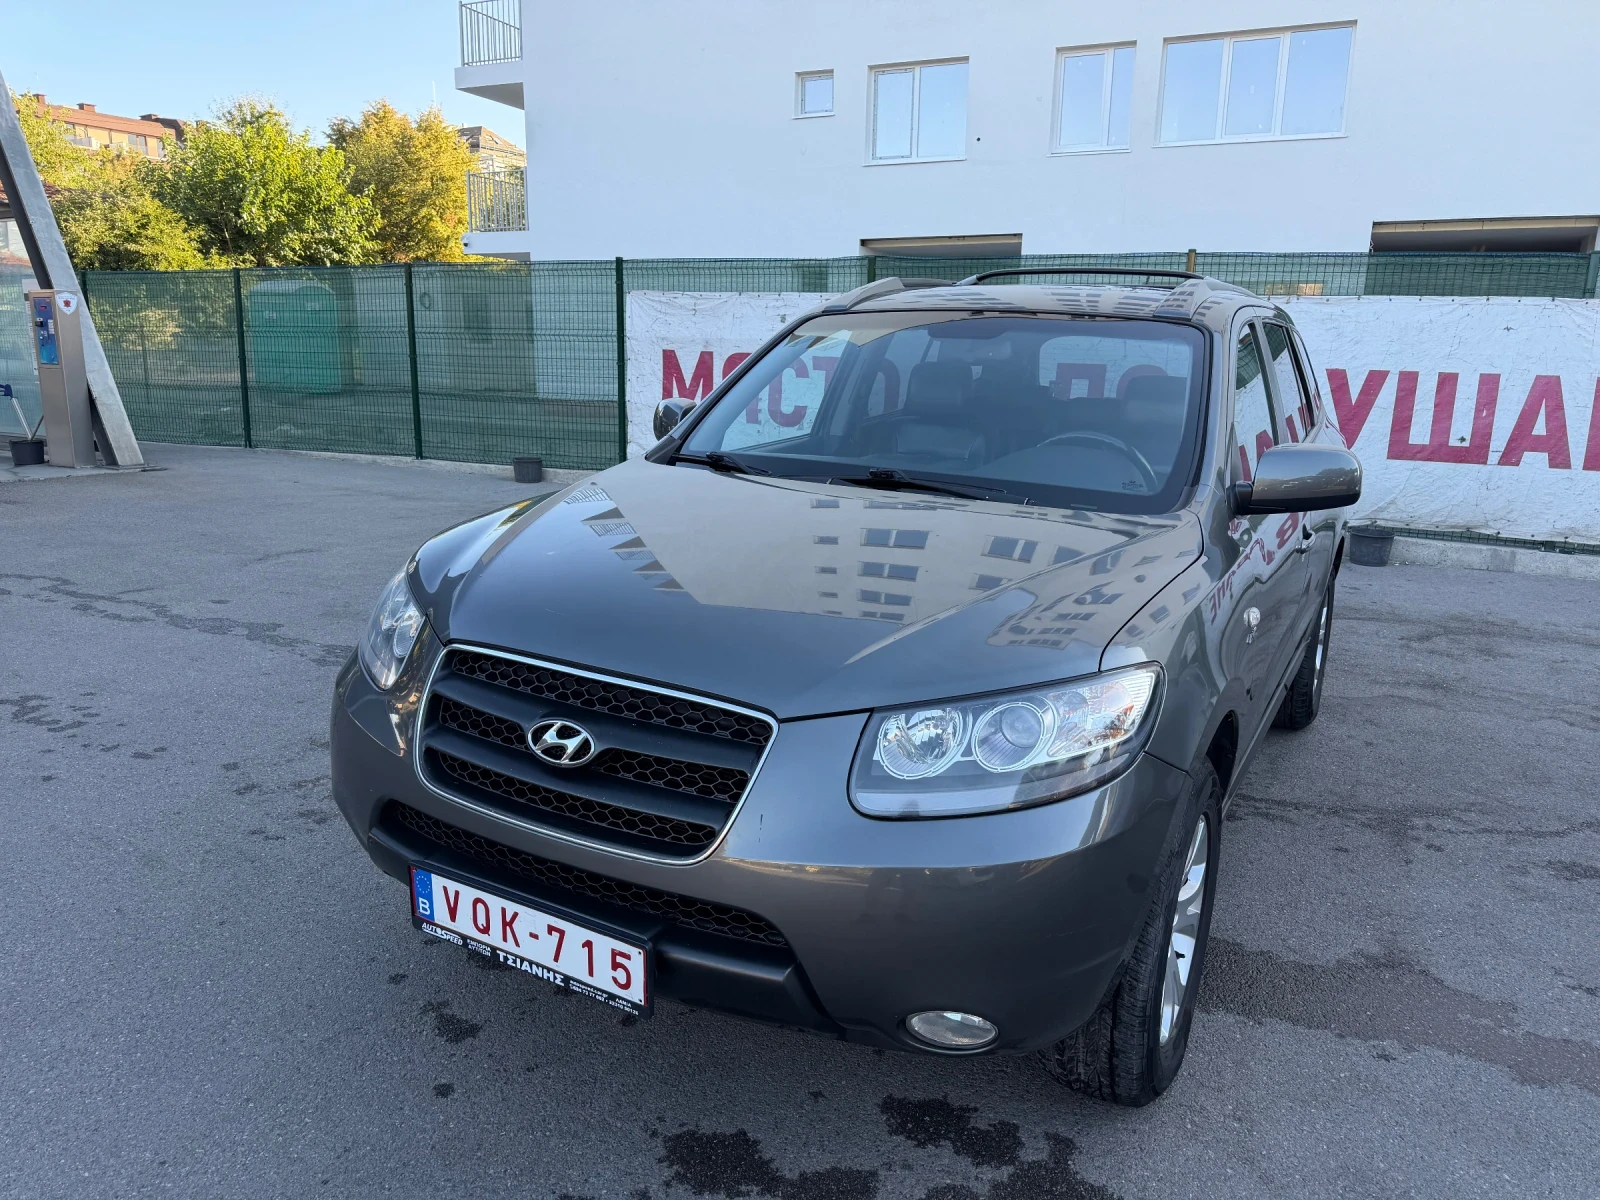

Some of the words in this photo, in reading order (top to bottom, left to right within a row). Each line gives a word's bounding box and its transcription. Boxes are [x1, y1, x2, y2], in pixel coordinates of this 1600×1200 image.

[418, 897, 431, 915] B
[442, 885, 632, 991] VQK-715
[496, 950, 565, 987] ΤΣΙΑΝΗΣ
